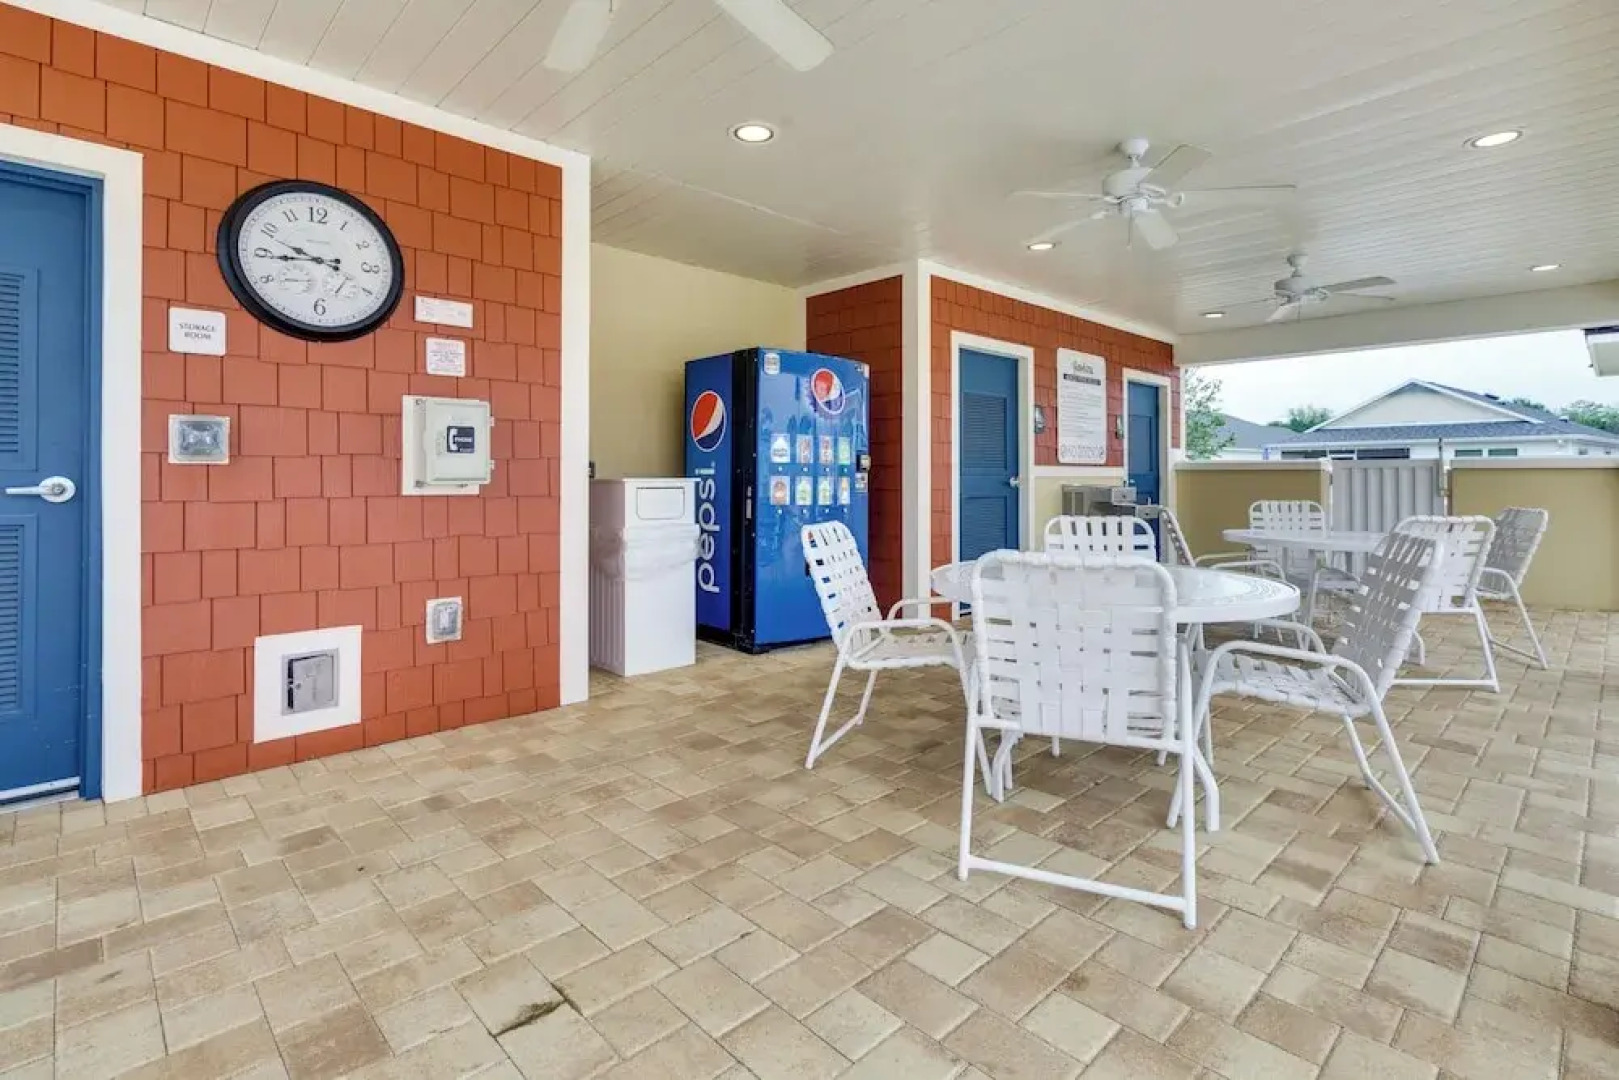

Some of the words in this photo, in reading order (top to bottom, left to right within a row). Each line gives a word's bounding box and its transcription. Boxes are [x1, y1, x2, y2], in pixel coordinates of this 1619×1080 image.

[282, 208, 299, 223] 11
[308, 206, 328, 225] 12
[261, 222, 279, 239] 10
[339, 220, 348, 231] 1
[356, 240, 370, 251] 2
[253, 246, 274, 260] 9
[361, 261, 380, 275] 3
[260, 274, 275, 284] 8
[313, 297, 327, 316] 6
[184, 331, 211, 340] ROOM
[695, 467, 721, 594] pepsi
